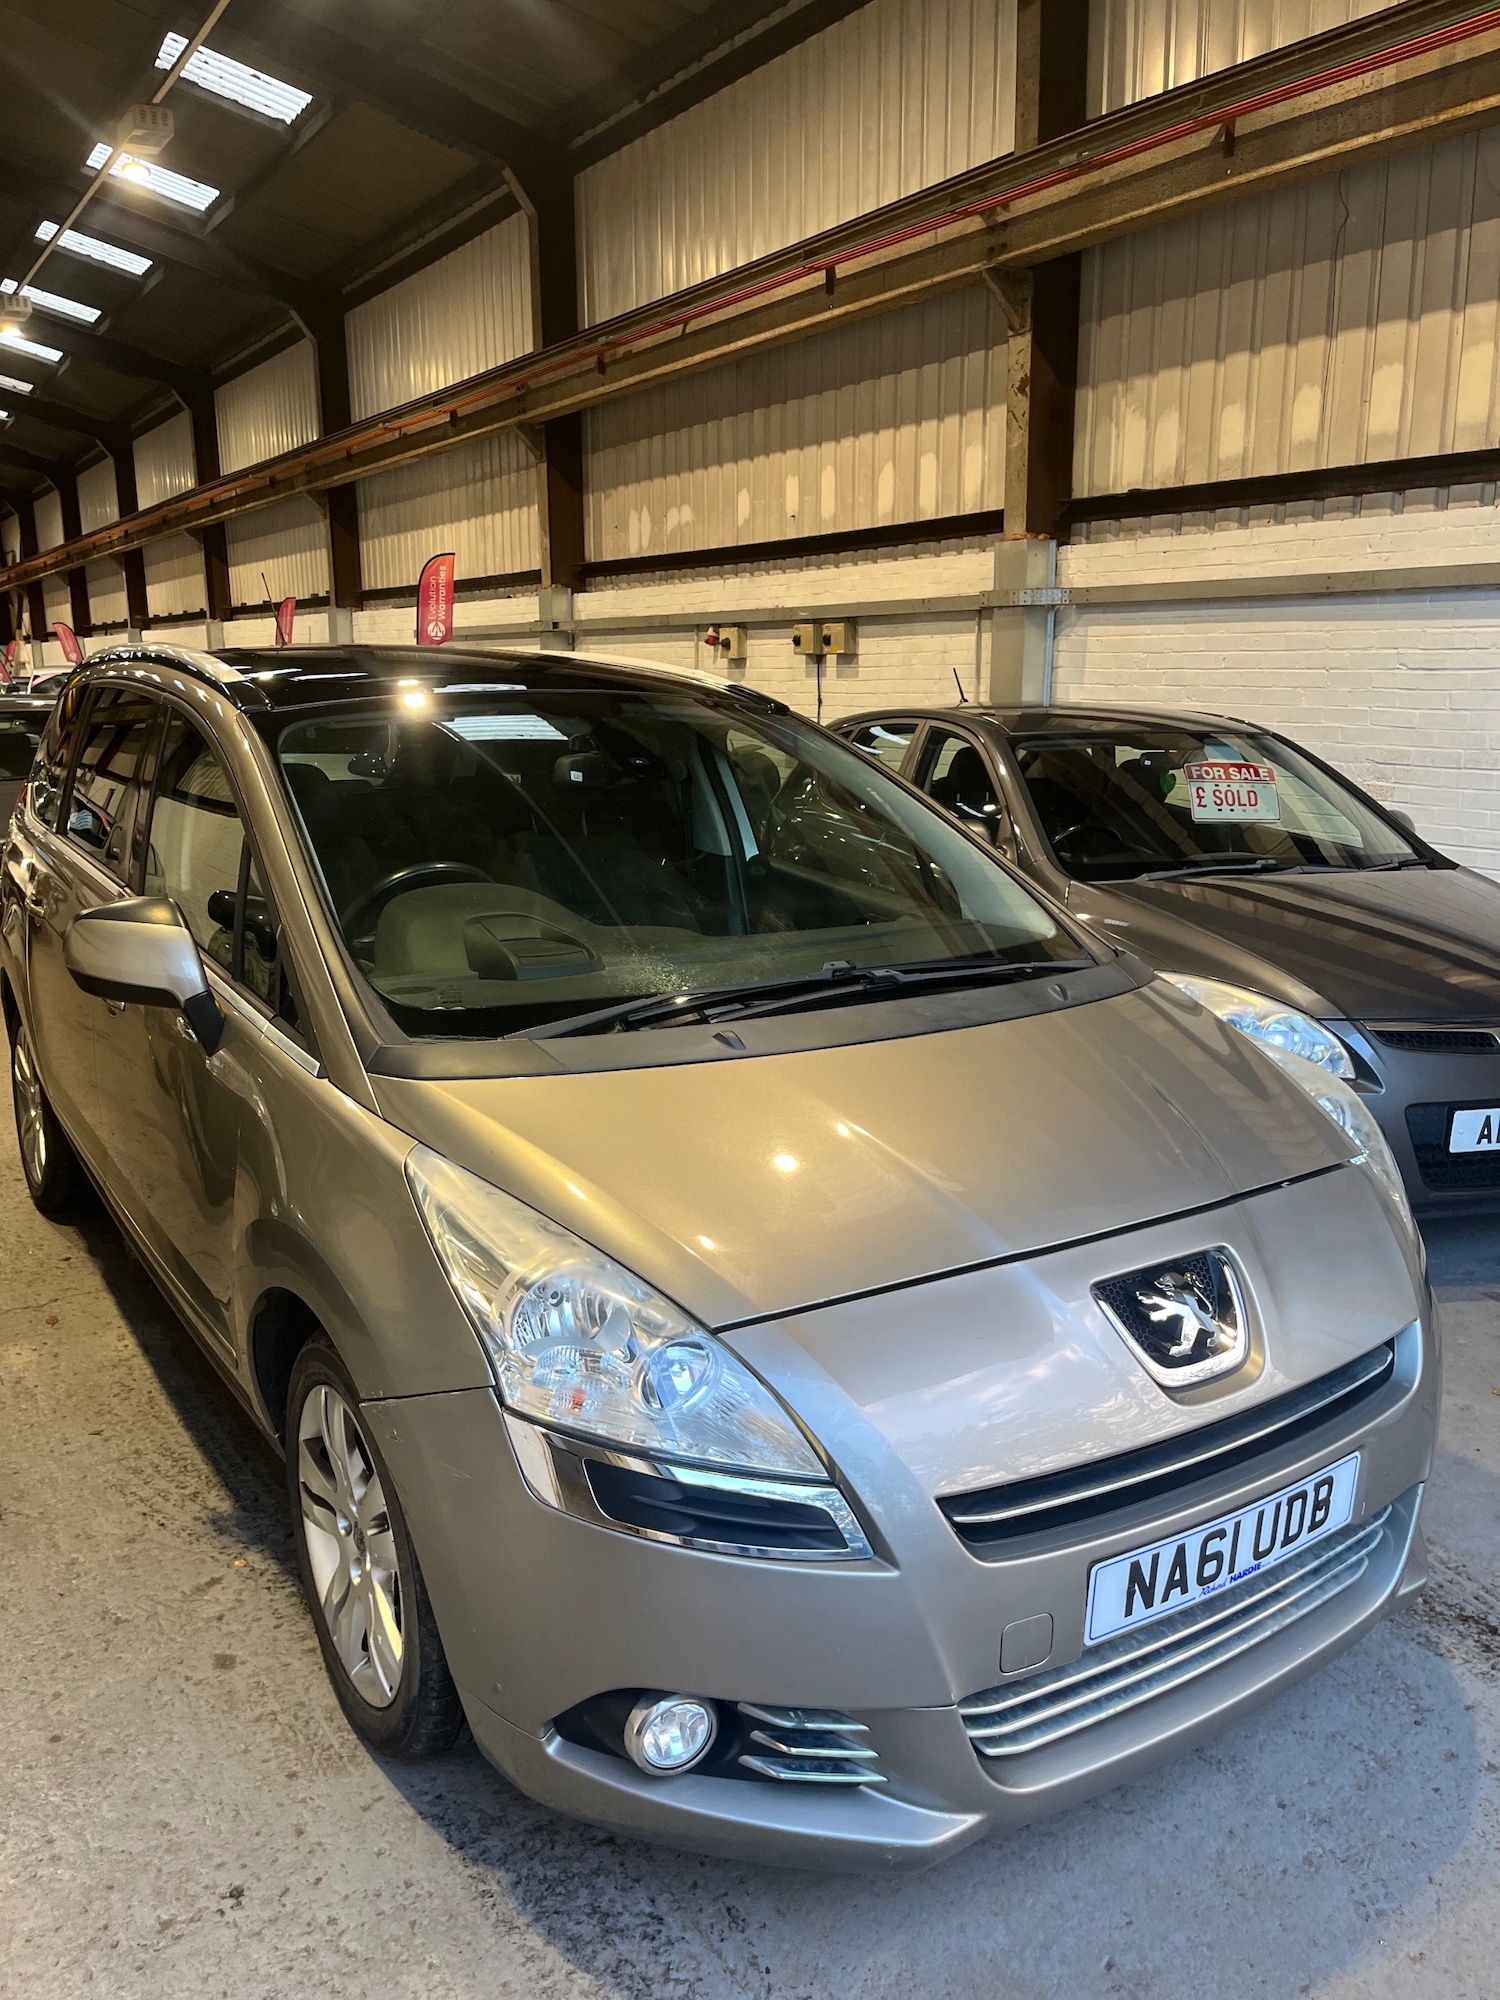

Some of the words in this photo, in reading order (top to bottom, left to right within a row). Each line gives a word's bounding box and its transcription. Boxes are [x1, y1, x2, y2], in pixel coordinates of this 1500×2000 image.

[428, 576, 437, 620] Evolution
[438, 565, 447, 620] Warranties
[1190, 766, 1226, 780] FOR
[1228, 767, 1270, 781] SALE
[1195, 786, 1207, 808] £
[1212, 788, 1259, 808] SOLD
[1124, 1519, 1242, 1619] NA61
[1252, 1475, 1335, 1562] UDB
[1229, 1562, 1262, 1584] HARDIE
